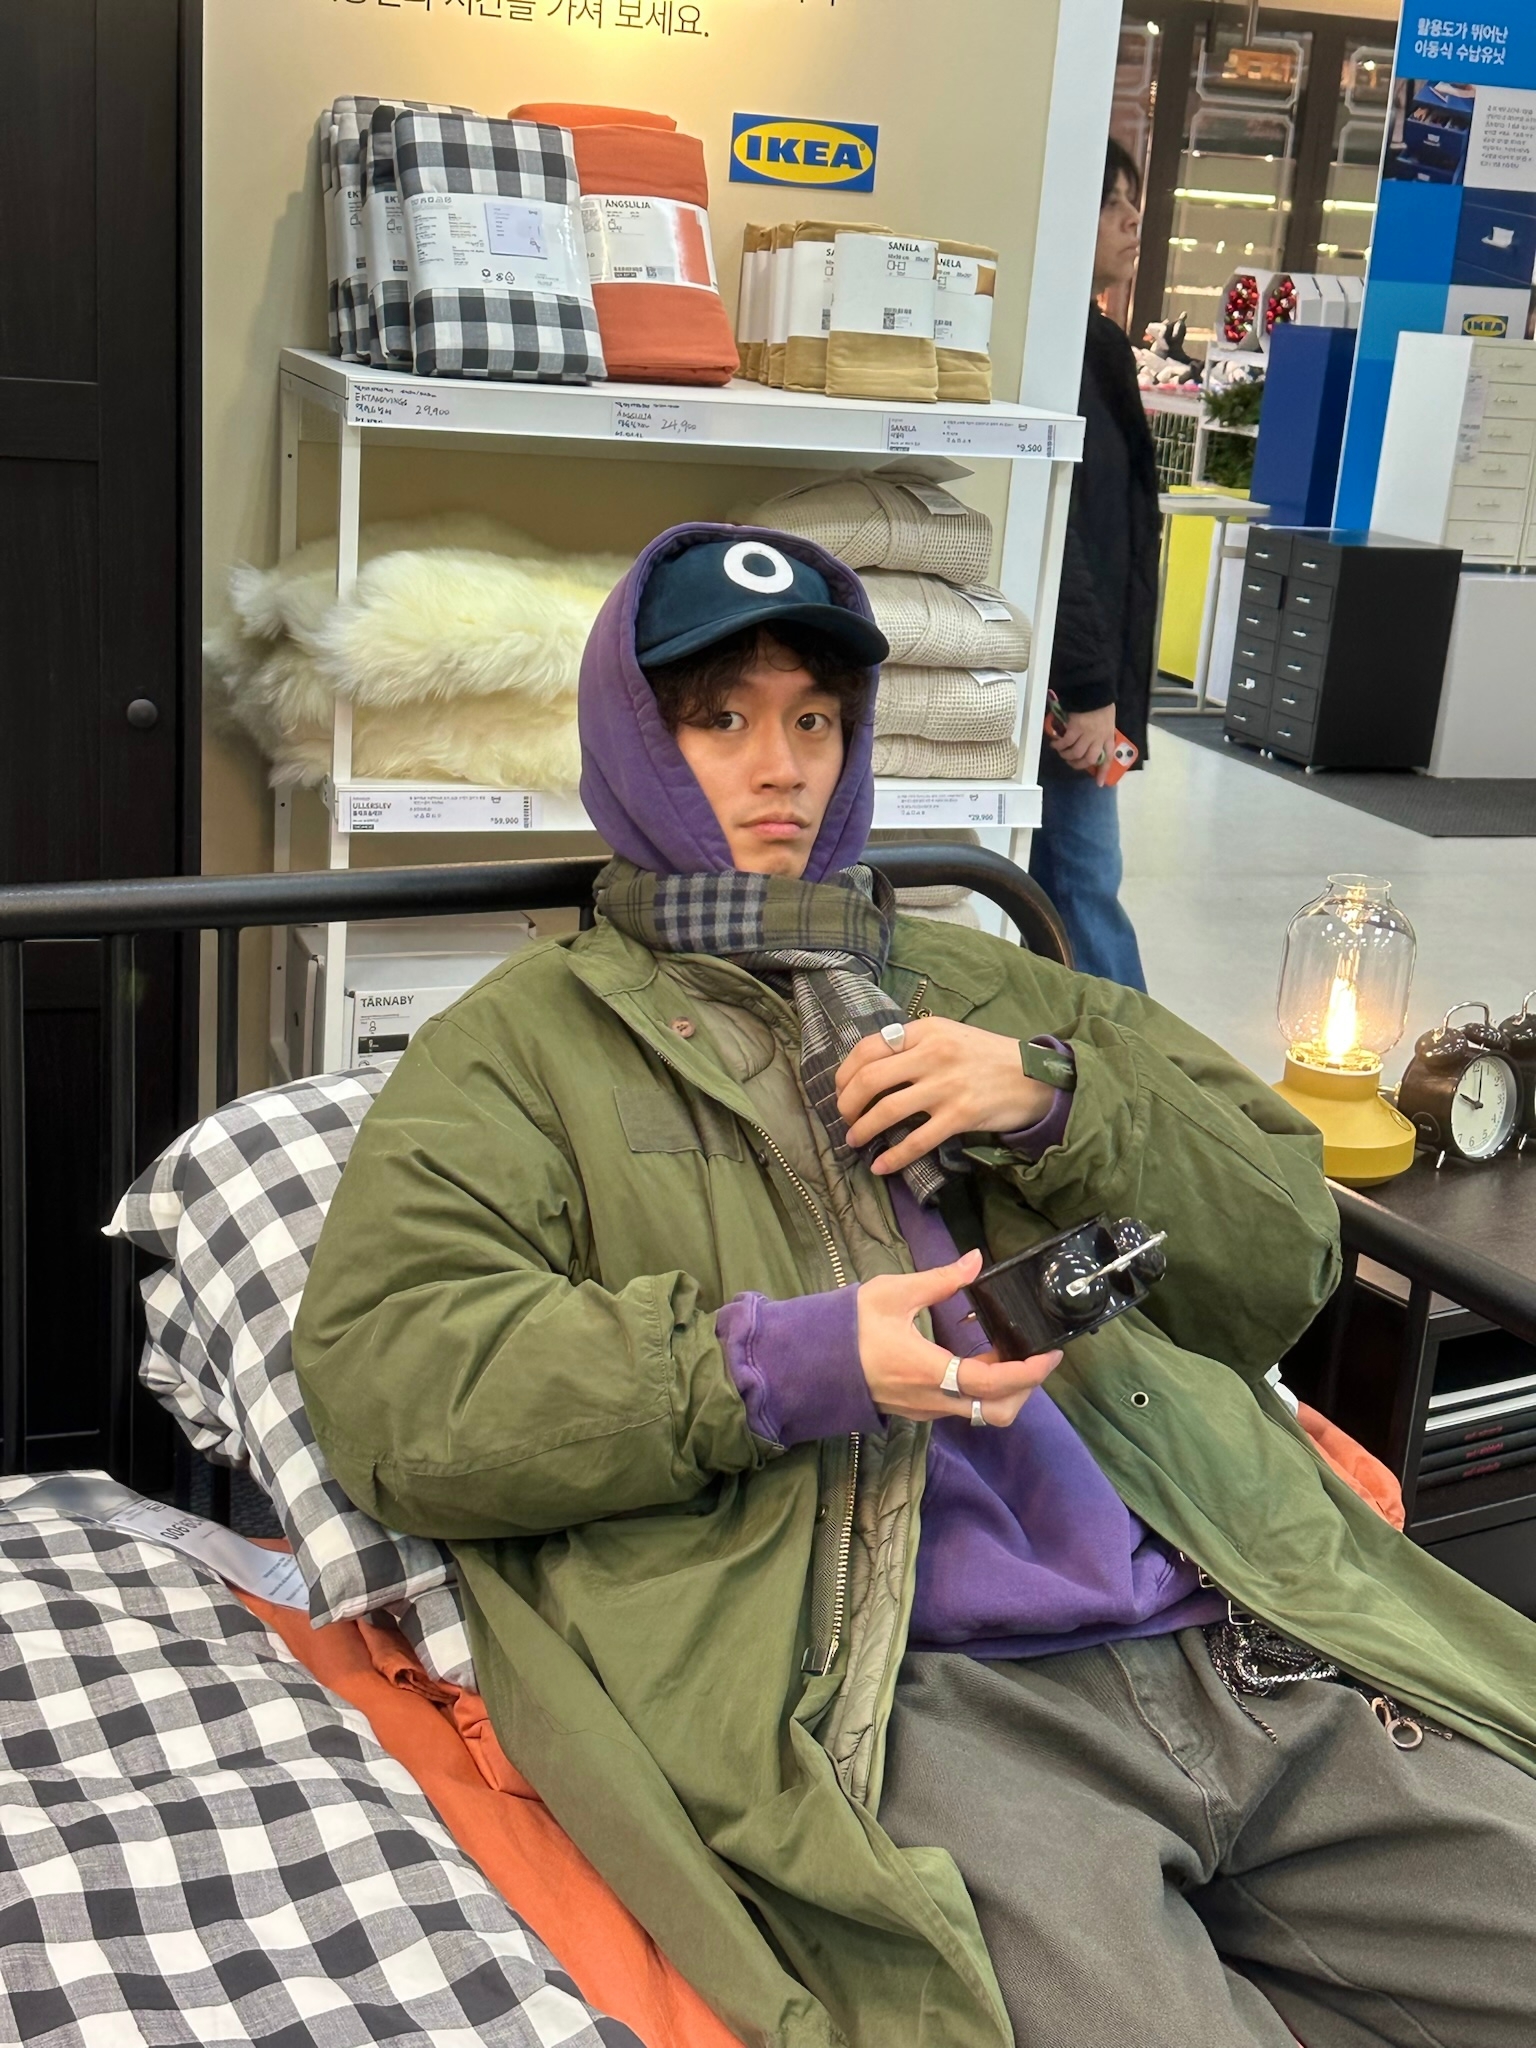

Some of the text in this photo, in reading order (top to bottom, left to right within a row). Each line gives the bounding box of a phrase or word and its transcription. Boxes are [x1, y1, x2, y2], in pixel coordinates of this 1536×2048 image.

[615, 0, 710, 37] 보세요.
[1417, 17, 1509, 45] 활용도가 뛰어난
[1414, 39, 1507, 65] 이동식 수납유닛
[746, 134, 864, 170] IKEA
[888, 241, 921, 252] SANELA
[1467, 320, 1503, 332] IKEA
[890, 424, 917, 432] SANELA
[360, 995, 415, 1008] TÄRNABY
